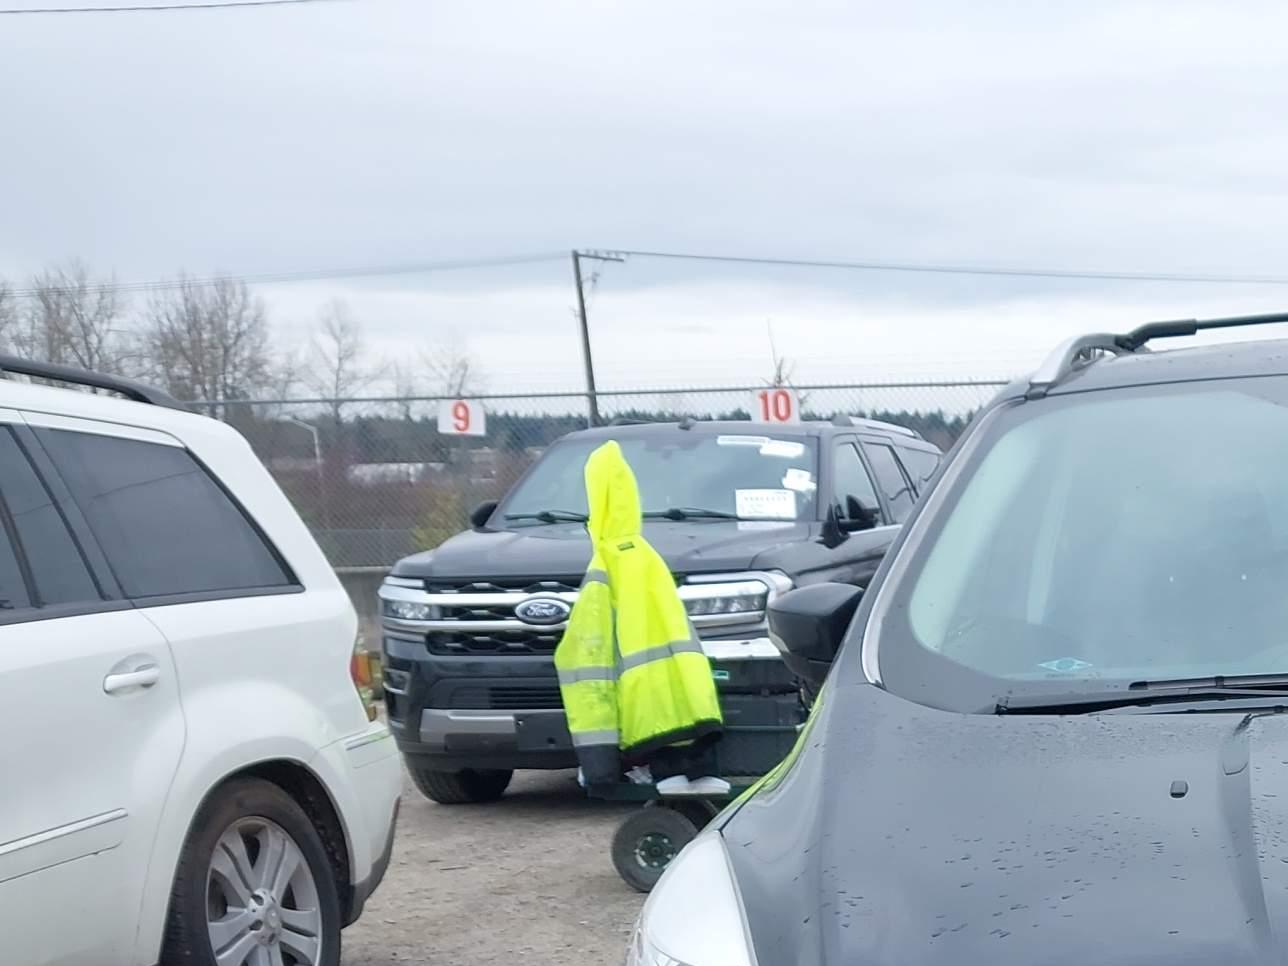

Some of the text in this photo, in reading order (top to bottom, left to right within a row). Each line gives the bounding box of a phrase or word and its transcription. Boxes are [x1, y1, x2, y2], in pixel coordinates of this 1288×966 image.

[453, 401, 469, 431] 9
[759, 389, 791, 422] 10
[527, 602, 558, 616] Ford
